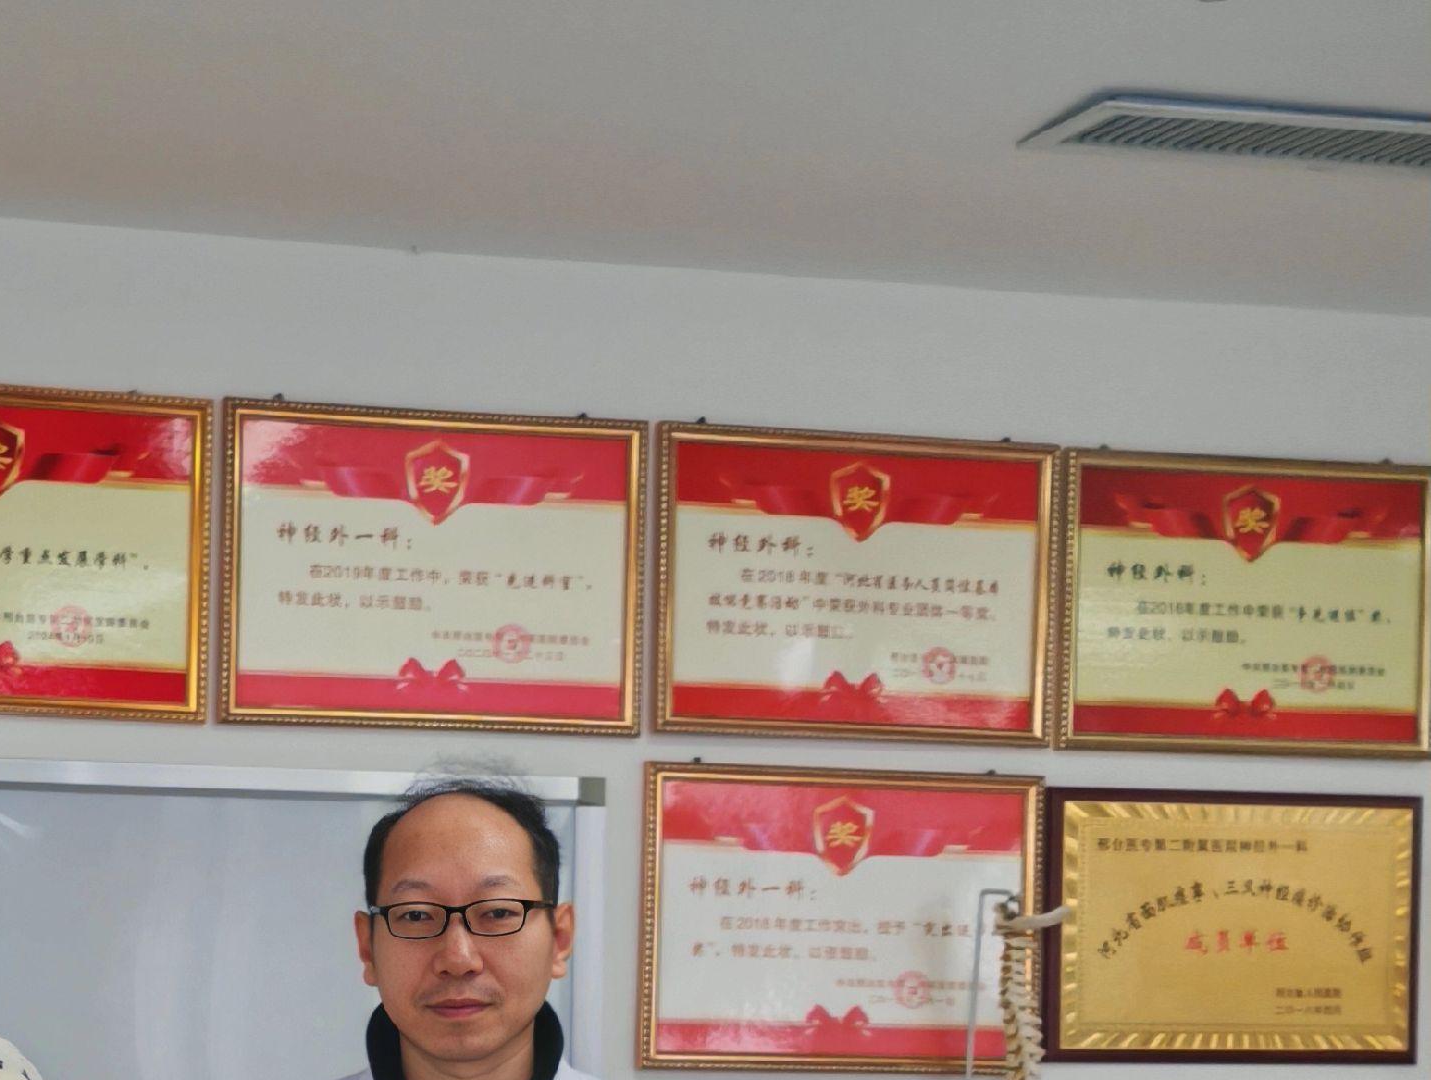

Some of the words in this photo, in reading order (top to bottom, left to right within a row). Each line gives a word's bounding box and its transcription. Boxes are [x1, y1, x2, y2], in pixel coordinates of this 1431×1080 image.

[420, 466, 457, 494] 奖
[843, 486, 879, 512] 奖
[1236, 507, 1269, 534] 奖
[827, 820, 863, 848] 奖
